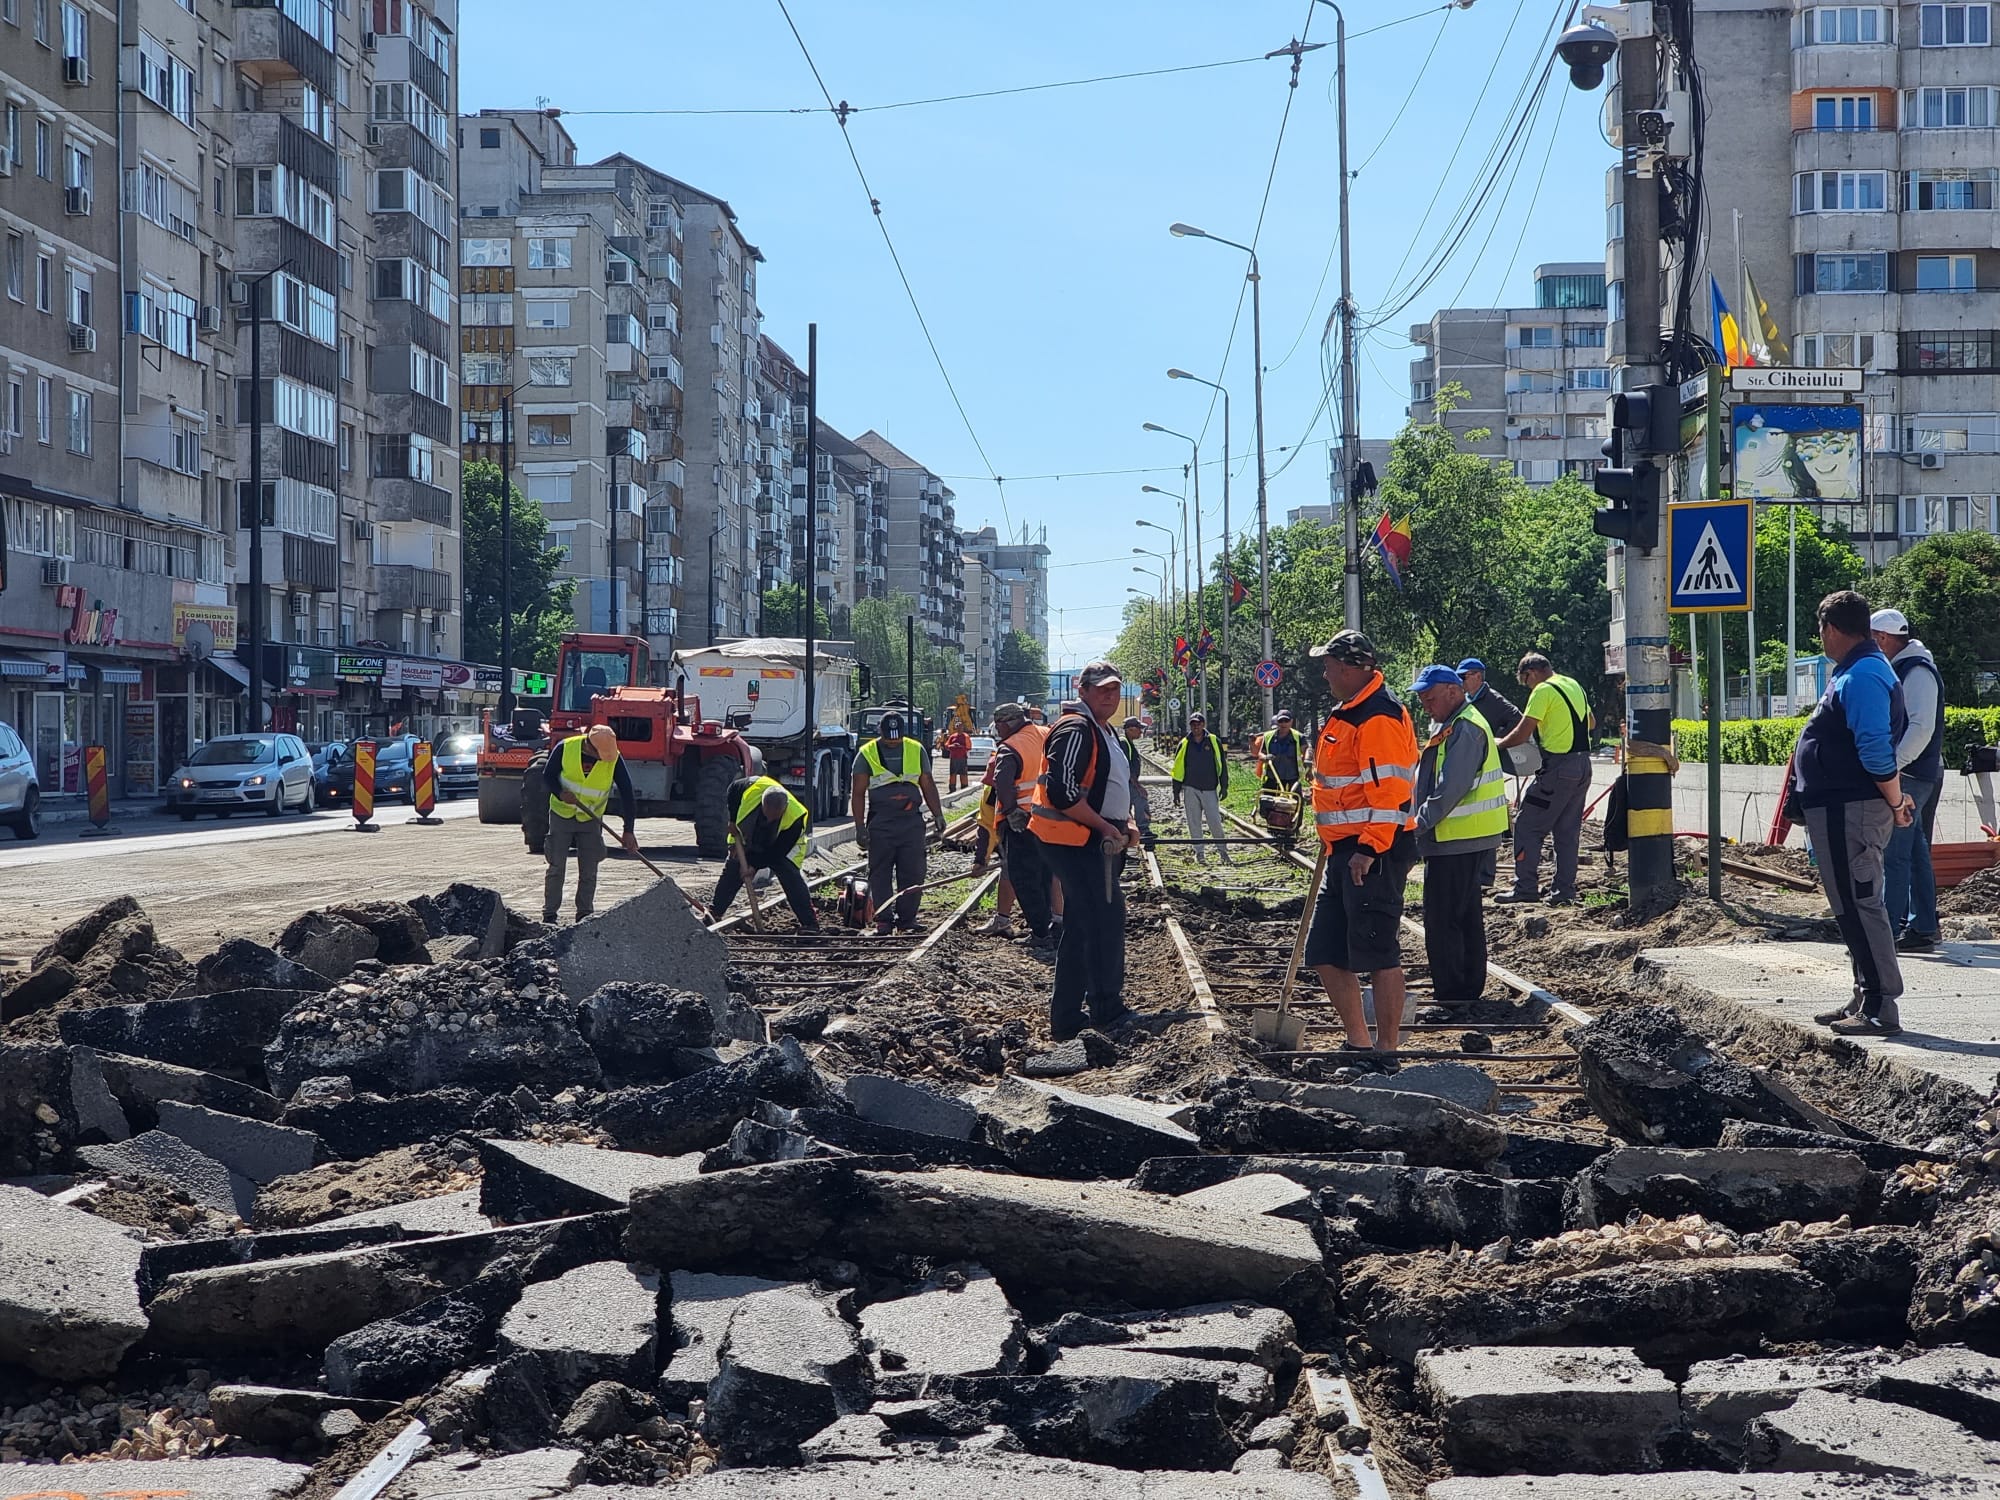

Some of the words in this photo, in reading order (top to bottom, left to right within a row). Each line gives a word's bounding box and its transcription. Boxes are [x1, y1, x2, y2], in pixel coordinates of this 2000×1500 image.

[1747, 376, 1765, 386] Str.
[1768, 371, 1844, 387] Ciheiului
[186, 612, 222, 620] COMISION
[478, 671, 502, 679] OPTIC
